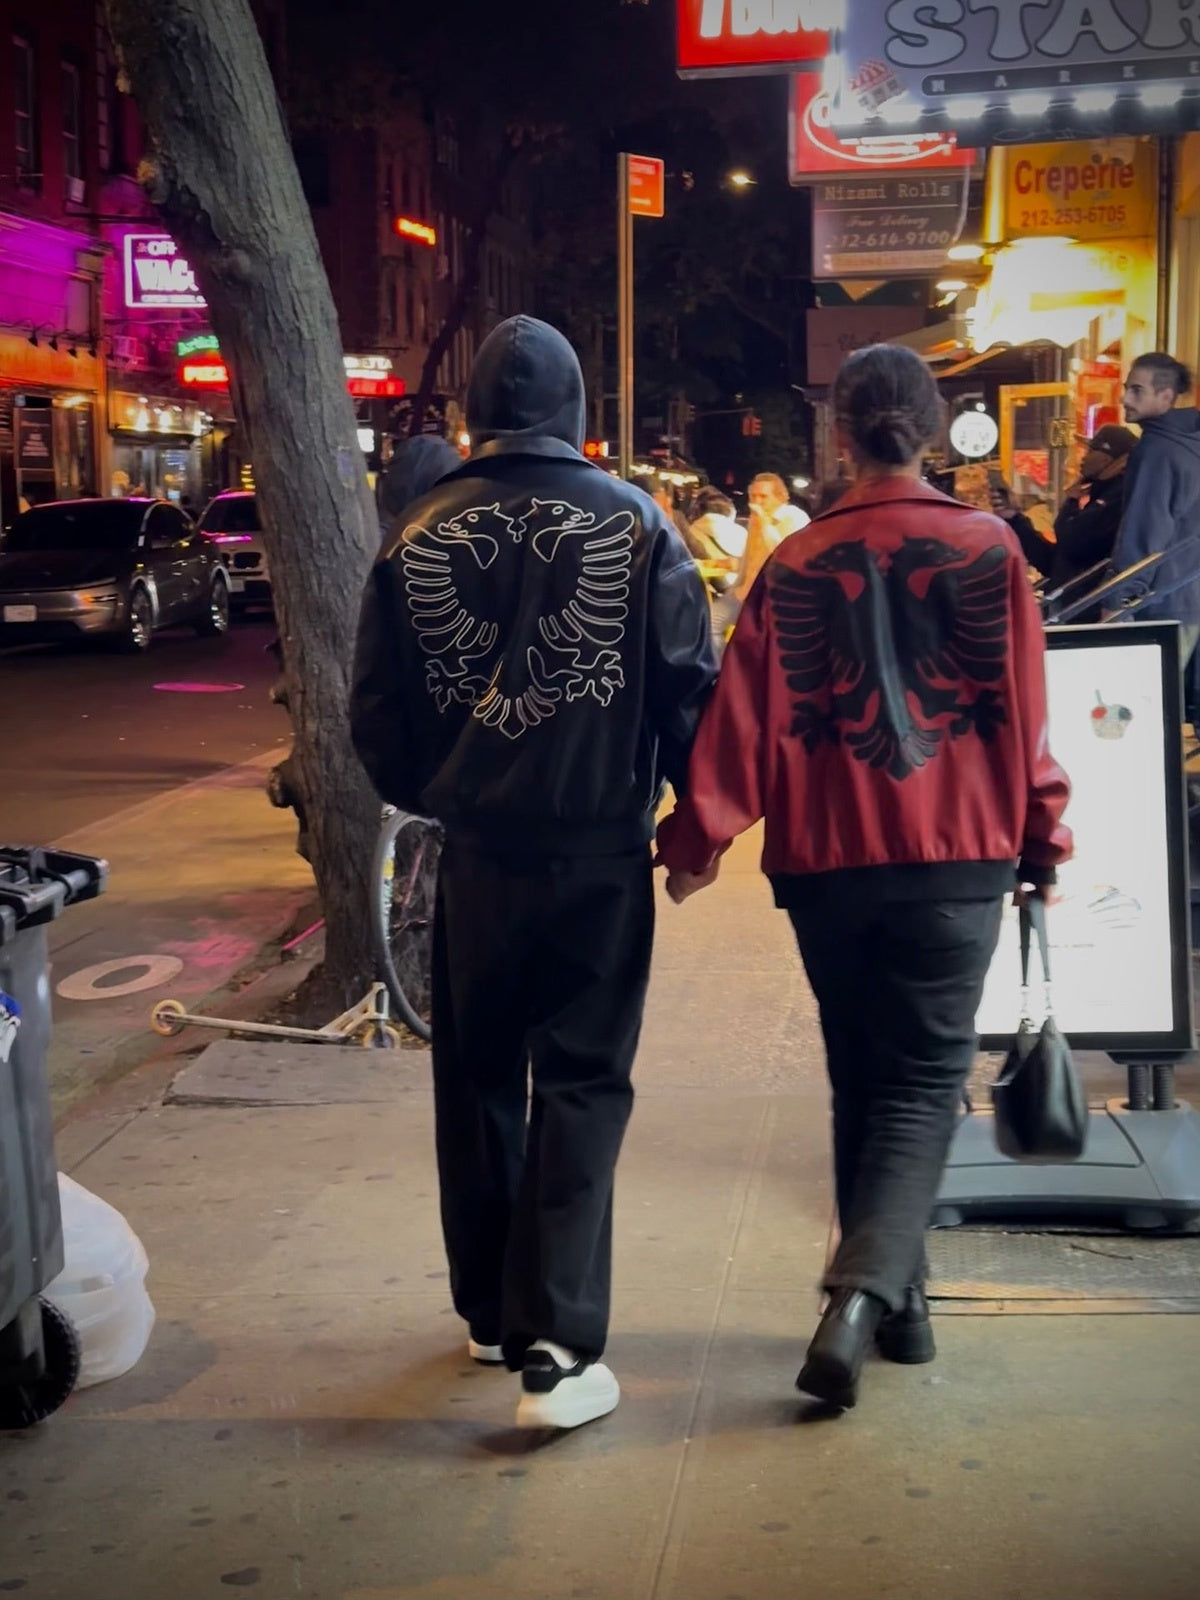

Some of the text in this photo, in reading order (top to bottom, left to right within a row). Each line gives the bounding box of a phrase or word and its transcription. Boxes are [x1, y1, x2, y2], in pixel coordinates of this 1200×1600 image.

[1014, 159, 1135, 200] Creperie
[897, 182, 951, 199] Rolls
[825, 231, 950, 248] 12-614-9100
